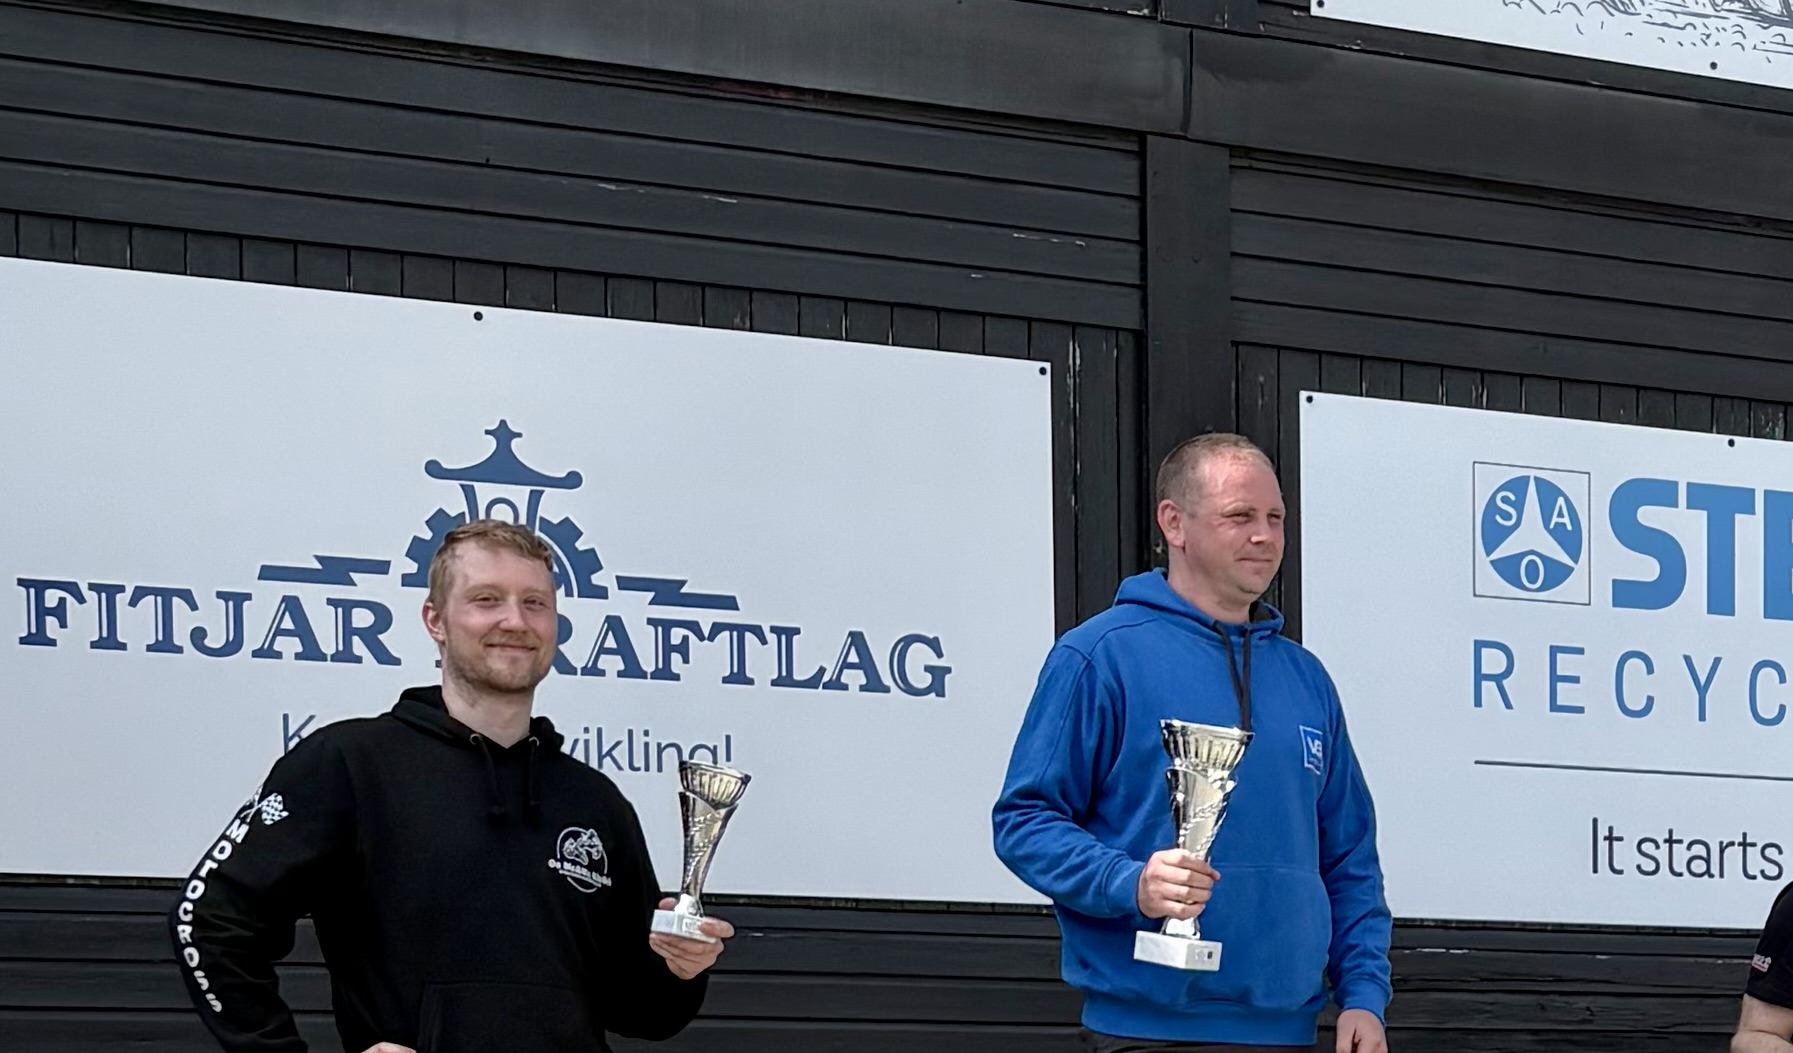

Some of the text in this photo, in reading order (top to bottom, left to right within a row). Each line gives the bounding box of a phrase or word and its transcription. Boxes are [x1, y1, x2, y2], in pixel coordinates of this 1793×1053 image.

[1495, 491, 1573, 531] S A
[16, 577, 953, 699] FITJAR AFTLAG
[1592, 817, 1625, 875] It
[1635, 828, 1784, 881] starts
[176, 817, 250, 1013] MOTOCROSS
